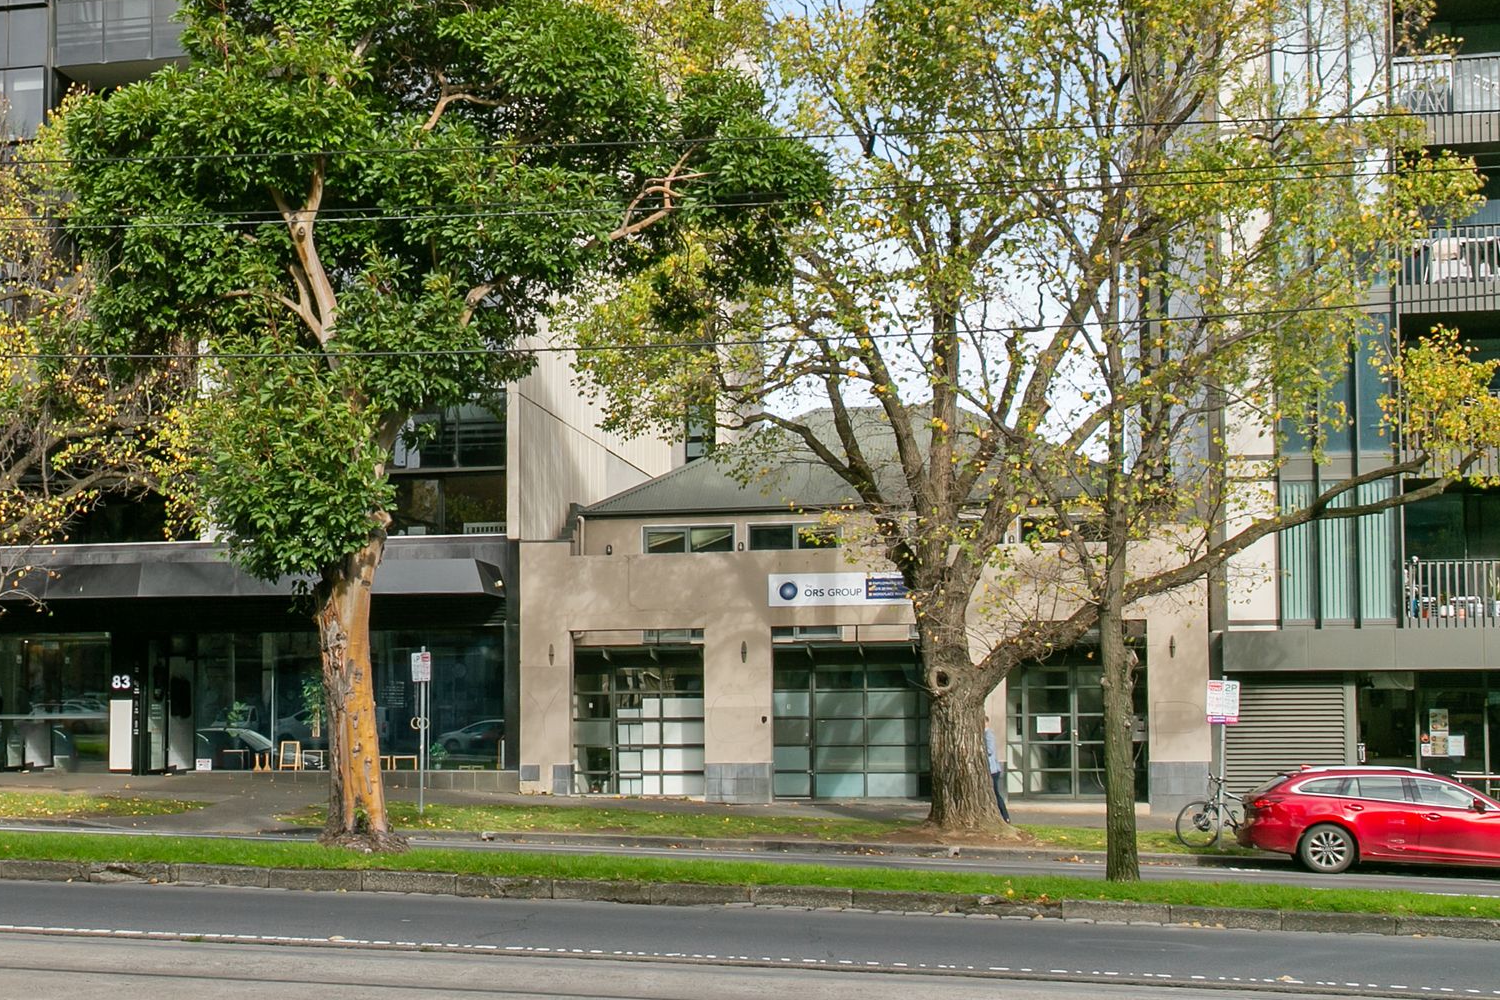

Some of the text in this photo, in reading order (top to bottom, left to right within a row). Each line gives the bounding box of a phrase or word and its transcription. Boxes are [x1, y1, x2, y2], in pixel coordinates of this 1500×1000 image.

[804, 588, 862, 597] ORS GROUP
[112, 675, 131, 689] 83
